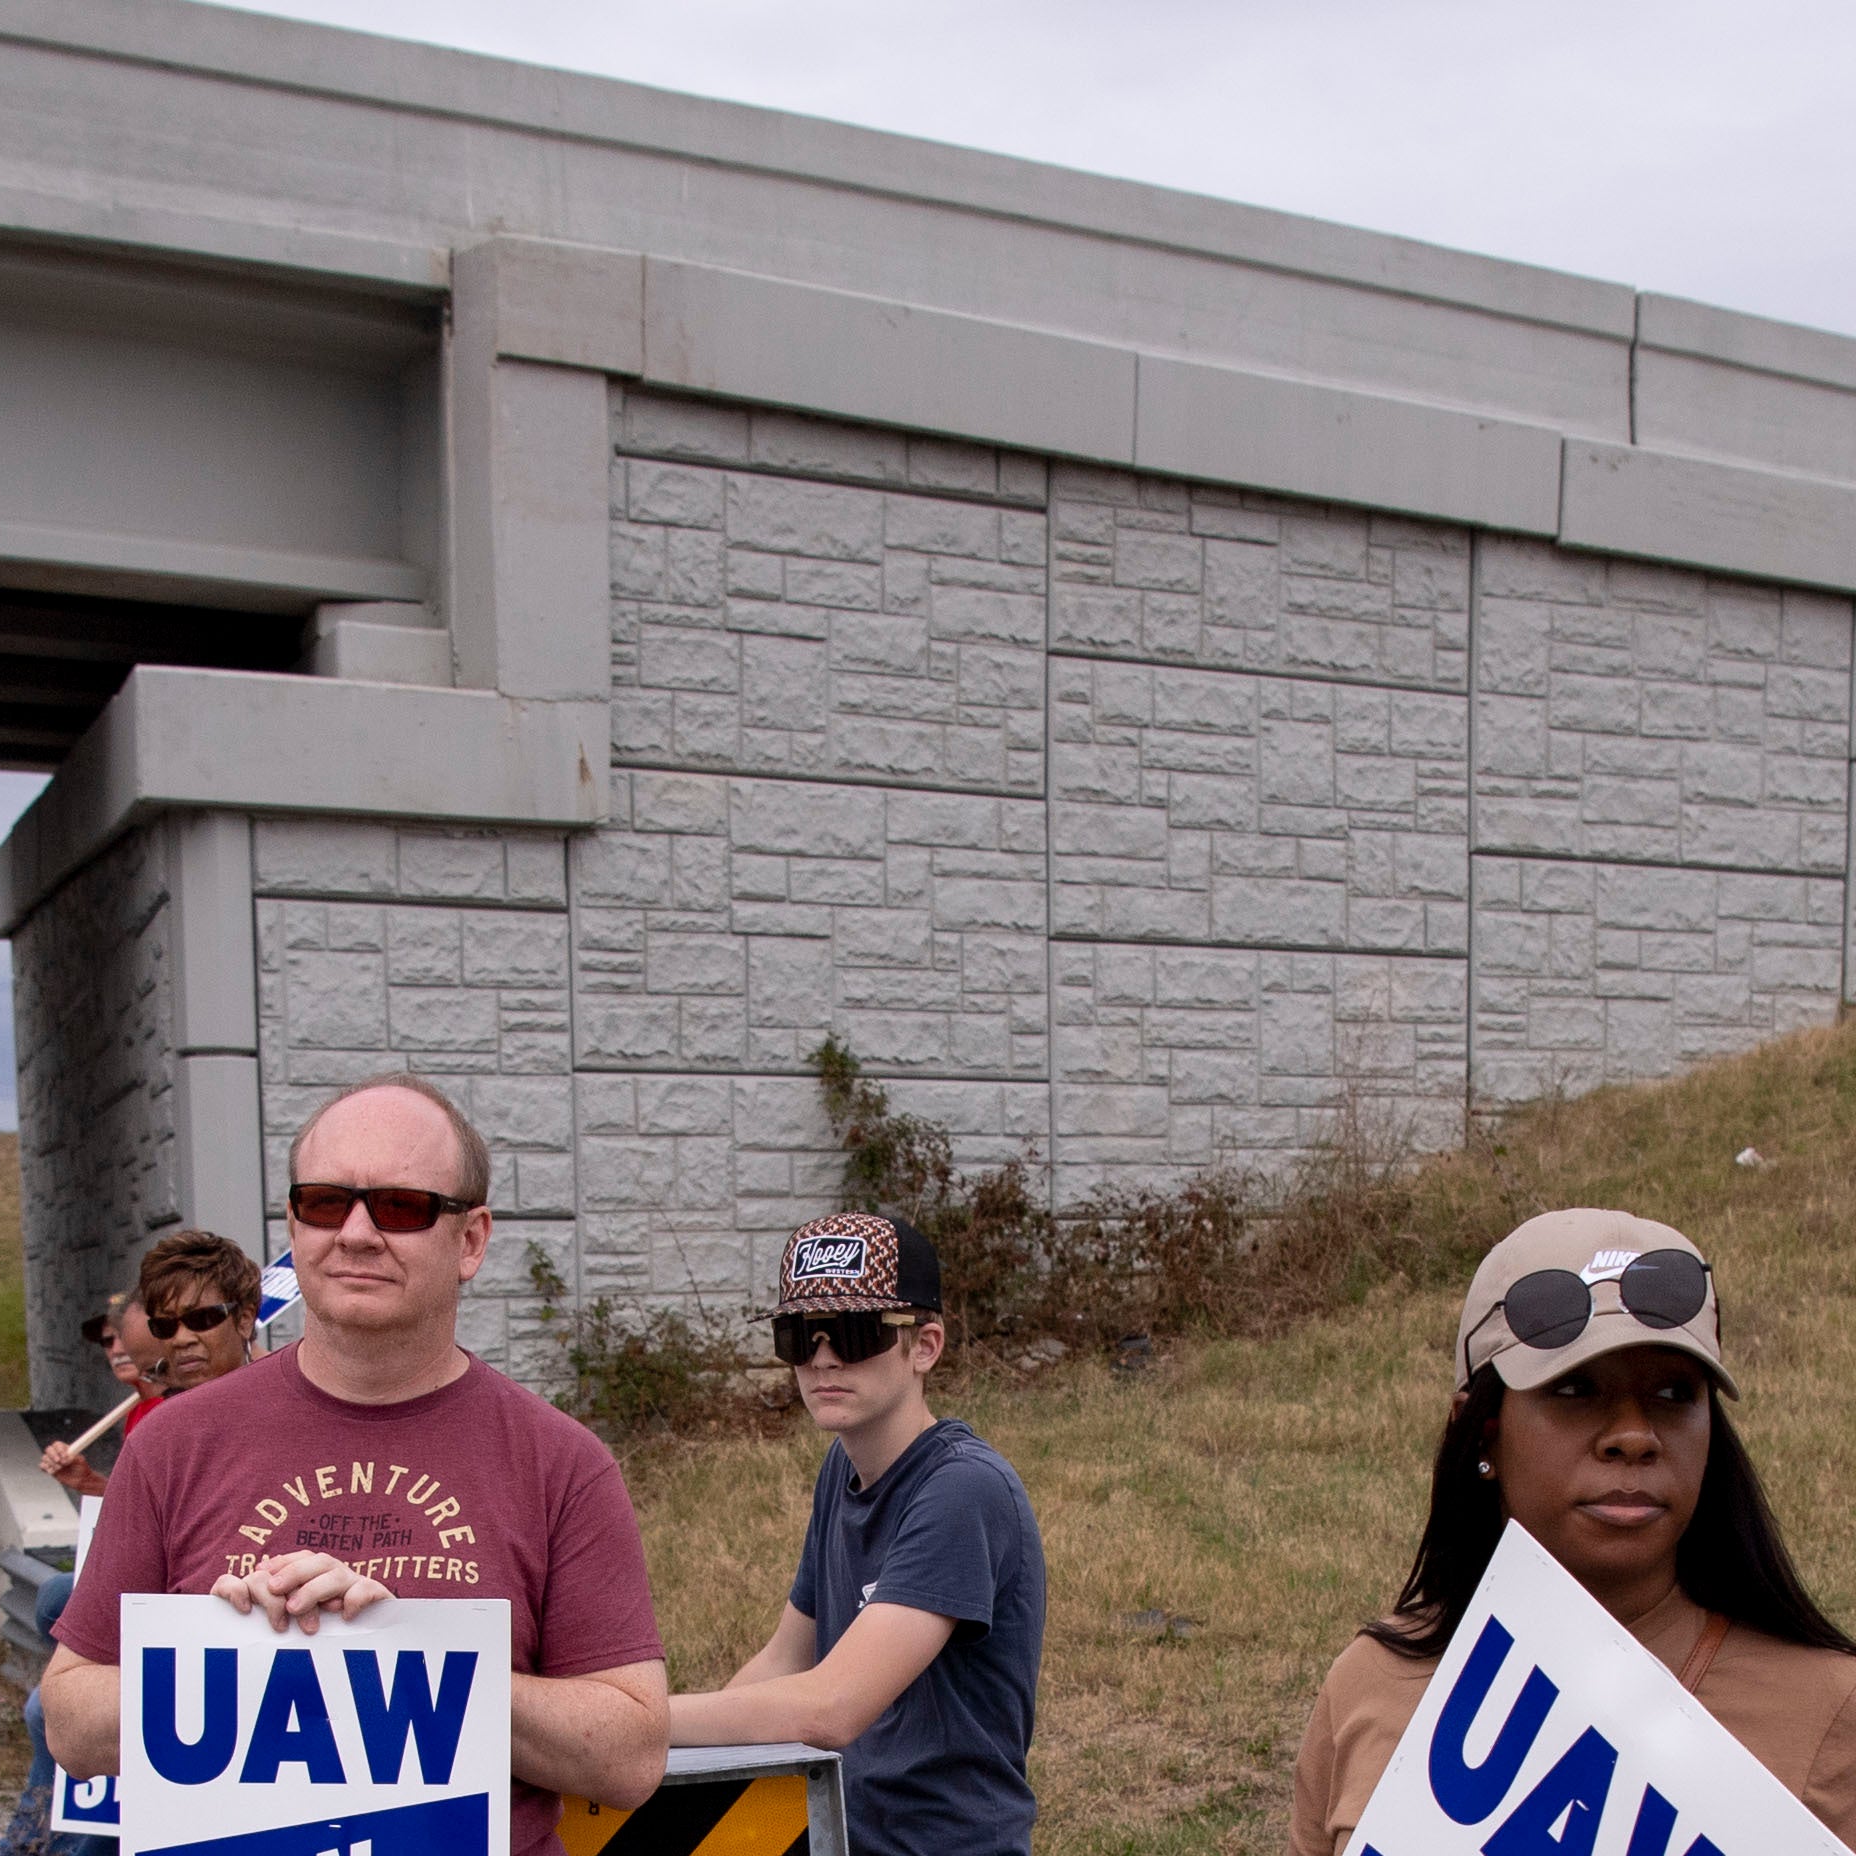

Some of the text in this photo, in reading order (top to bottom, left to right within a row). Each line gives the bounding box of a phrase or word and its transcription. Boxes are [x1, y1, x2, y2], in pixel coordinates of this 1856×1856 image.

[796, 1239, 861, 1275] Hooey
[238, 1461, 476, 1549] ADVENTURE
[319, 1513, 393, 1530] OFF THE
[295, 1528, 413, 1551] BEATEN PATH
[141, 1646, 479, 1786] UAW
